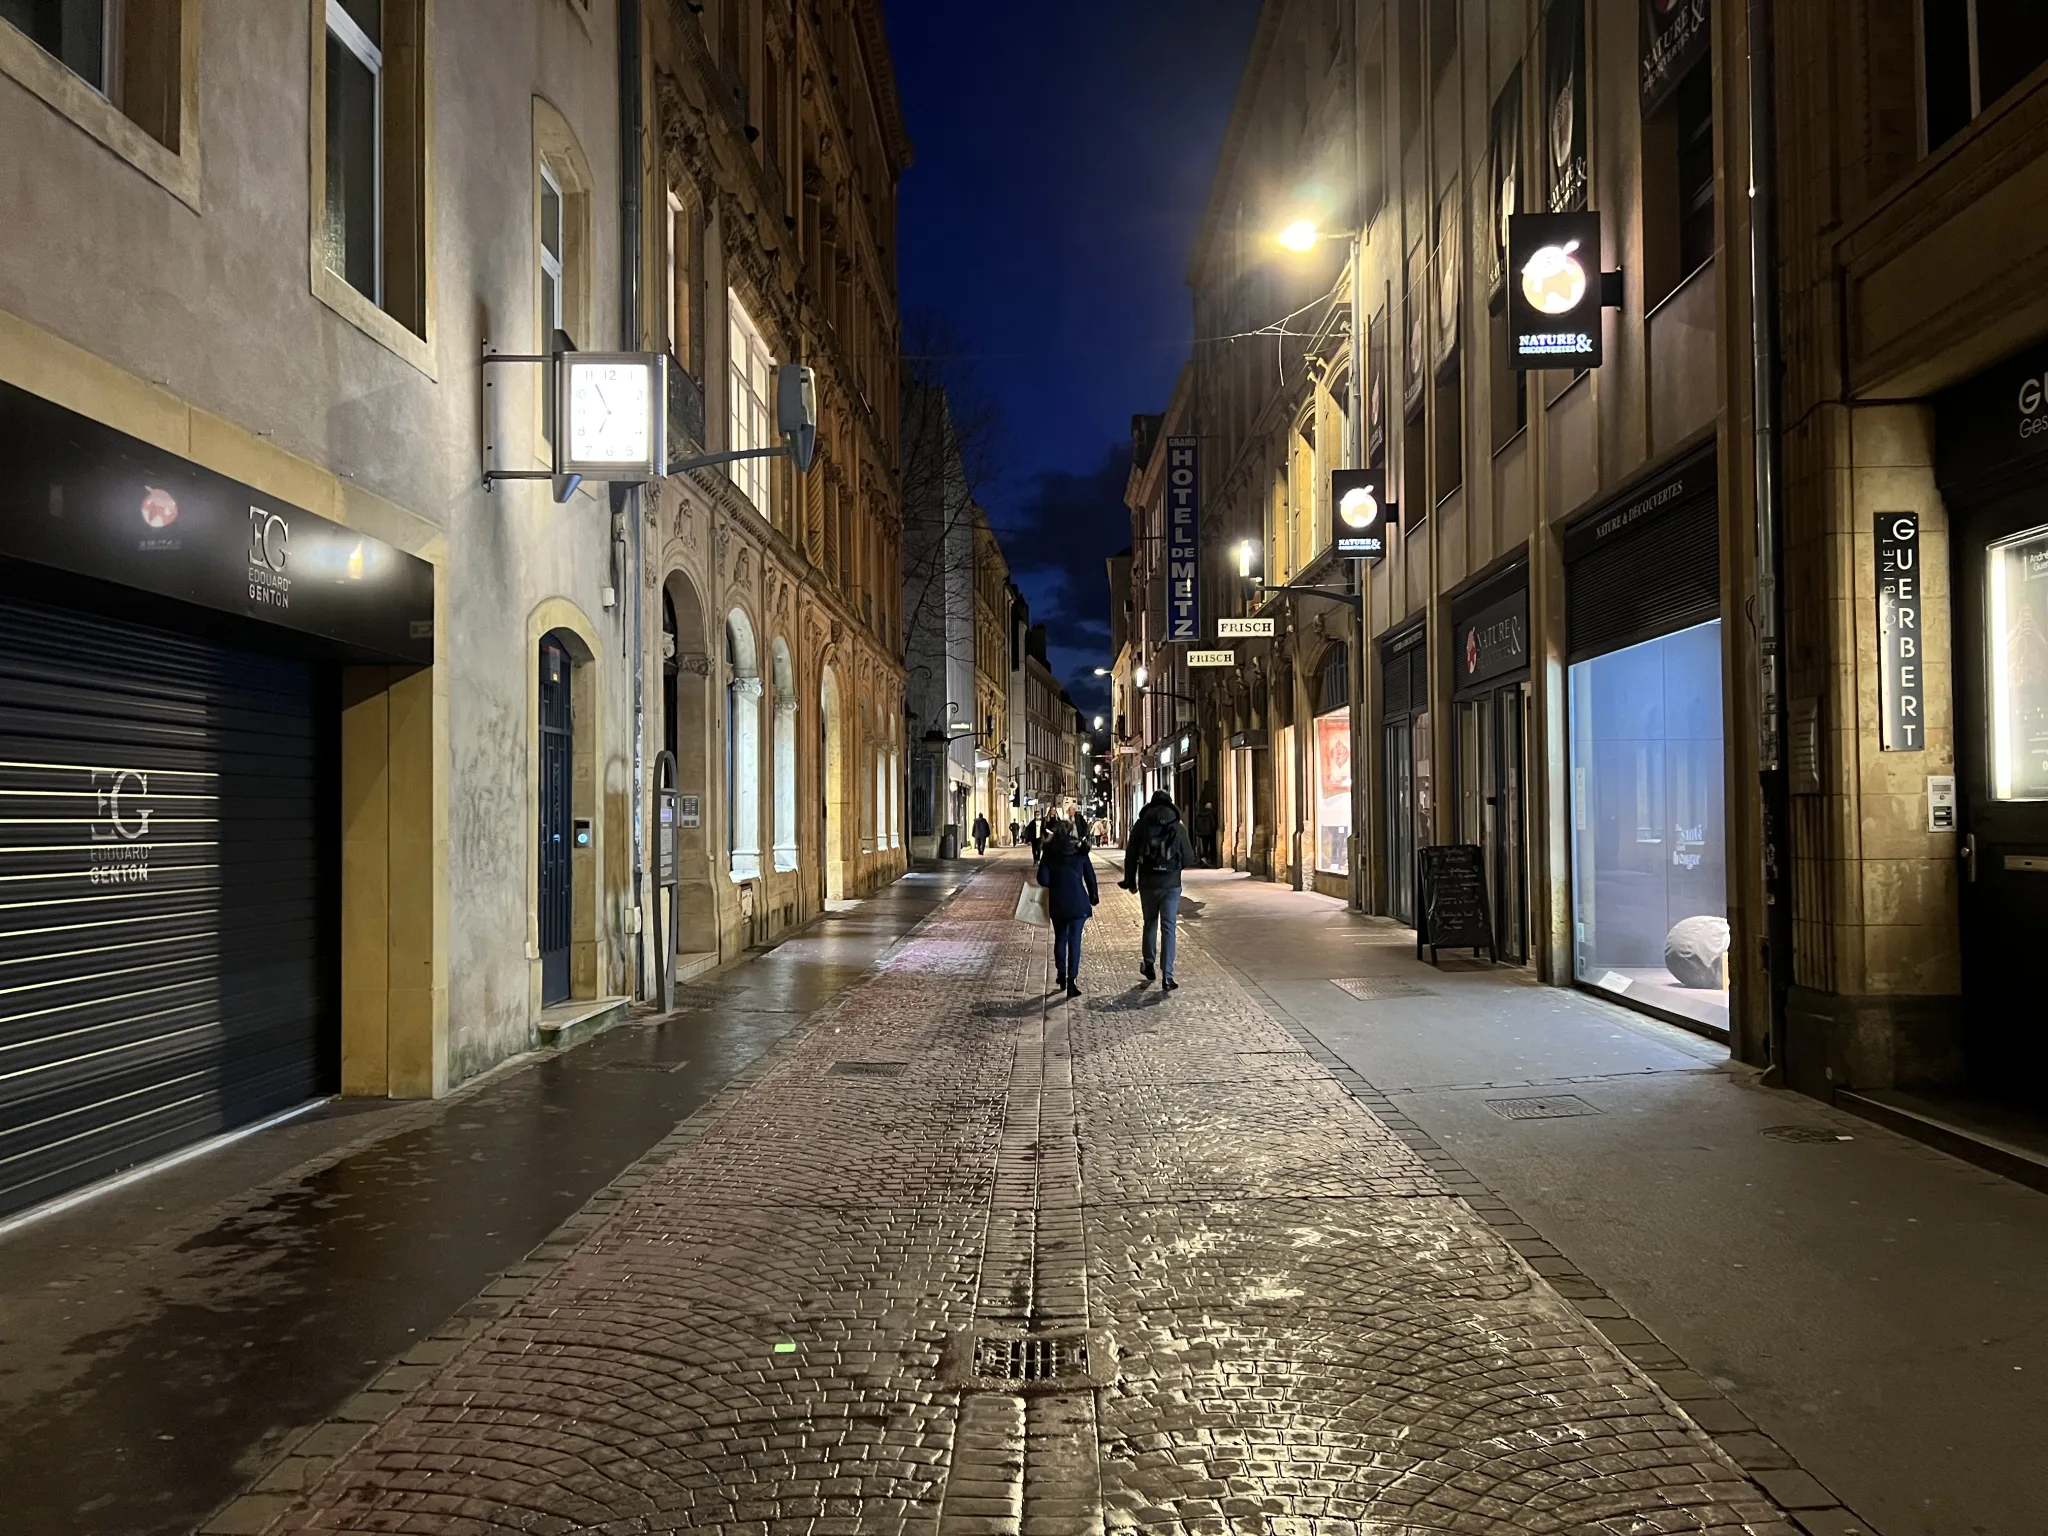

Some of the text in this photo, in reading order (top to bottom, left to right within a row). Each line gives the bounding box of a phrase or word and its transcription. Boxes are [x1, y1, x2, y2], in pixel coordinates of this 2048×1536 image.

[1519, 334, 1577, 346] NATURE
[585, 370, 593, 381] 11
[604, 370, 617, 381] 12
[1169, 438, 1197, 447] GRAND
[585, 445, 593, 456] 7
[1172, 450, 1194, 543] HOTEL
[1171, 548, 1195, 558] DE
[1882, 538, 1897, 627] CABINET
[249, 583, 289, 609] GENTON
[1171, 562, 1195, 636] METZ
[1220, 622, 1272, 633] FRISCH
[1892, 519, 1917, 746] GUERBERT
[1189, 654, 1232, 663] FRISCH
[90, 862, 149, 884] GENTON
